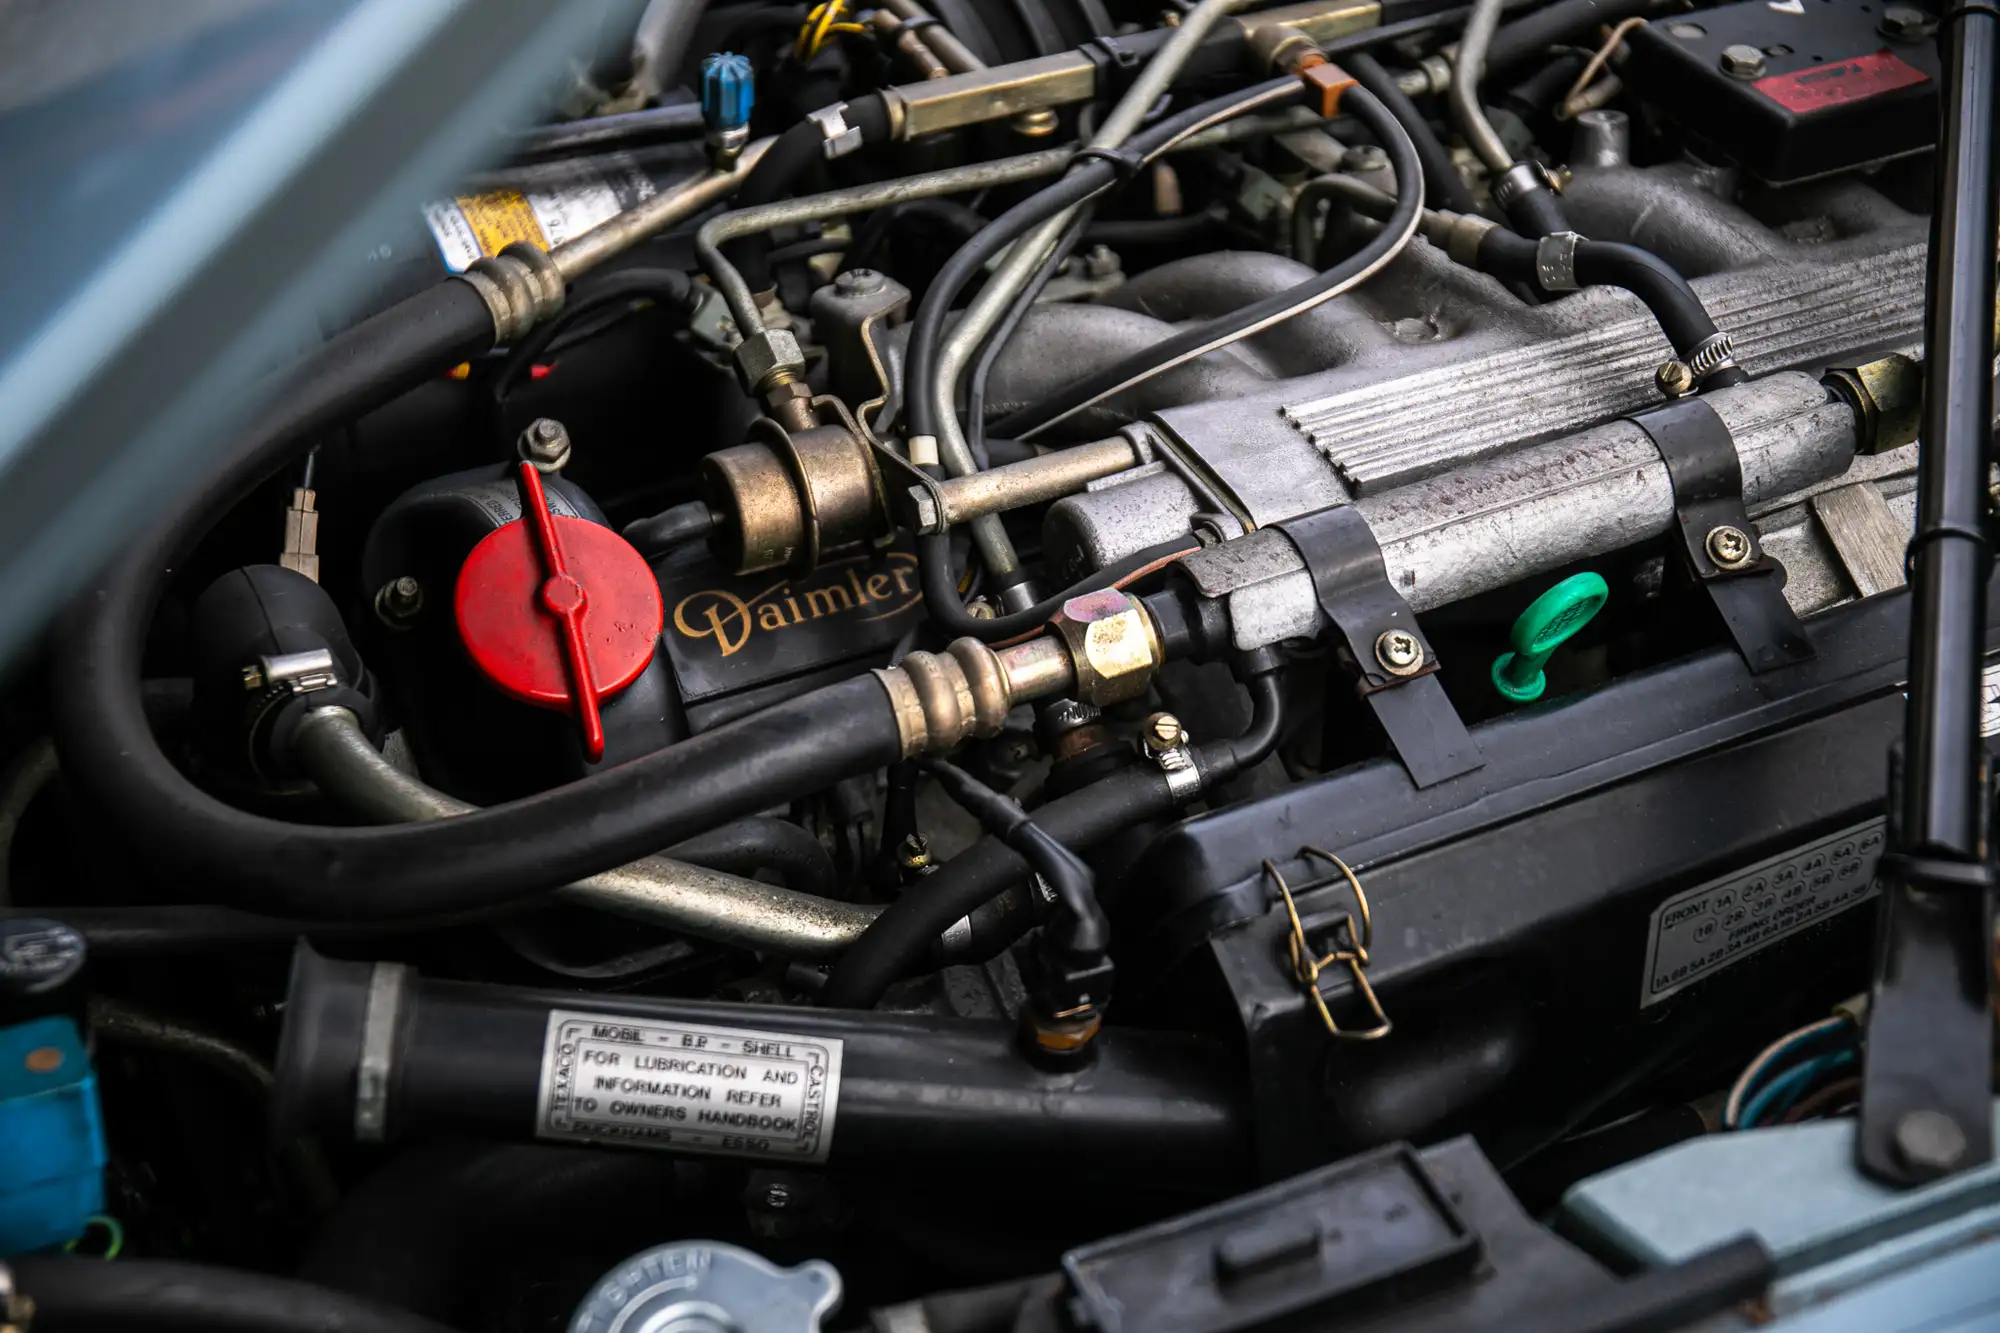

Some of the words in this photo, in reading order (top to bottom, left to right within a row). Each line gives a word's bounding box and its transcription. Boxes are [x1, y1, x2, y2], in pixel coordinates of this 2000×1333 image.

[673, 564, 916, 657] Daimler
[1663, 899, 1709, 926] FRONT
[1728, 917, 1770, 941] FIRING
[1773, 896, 1816, 920] ORDER
[591, 1024, 646, 1042] MOBIL
[742, 1039, 795, 1058] SHELL
[551, 1043, 576, 1111] TEXACO
[583, 1049, 622, 1066] FOR
[634, 1054, 748, 1080] LUBRICATION
[762, 1068, 799, 1085] AND
[593, 1075, 712, 1101] INFORMATION
[725, 1088, 783, 1109] REFER
[801, 1064, 826, 1141] CASTROL
[573, 1096, 599, 1113] TO
[609, 1100, 688, 1122] OWNERS
[697, 1108, 799, 1132] HANDBOOK
